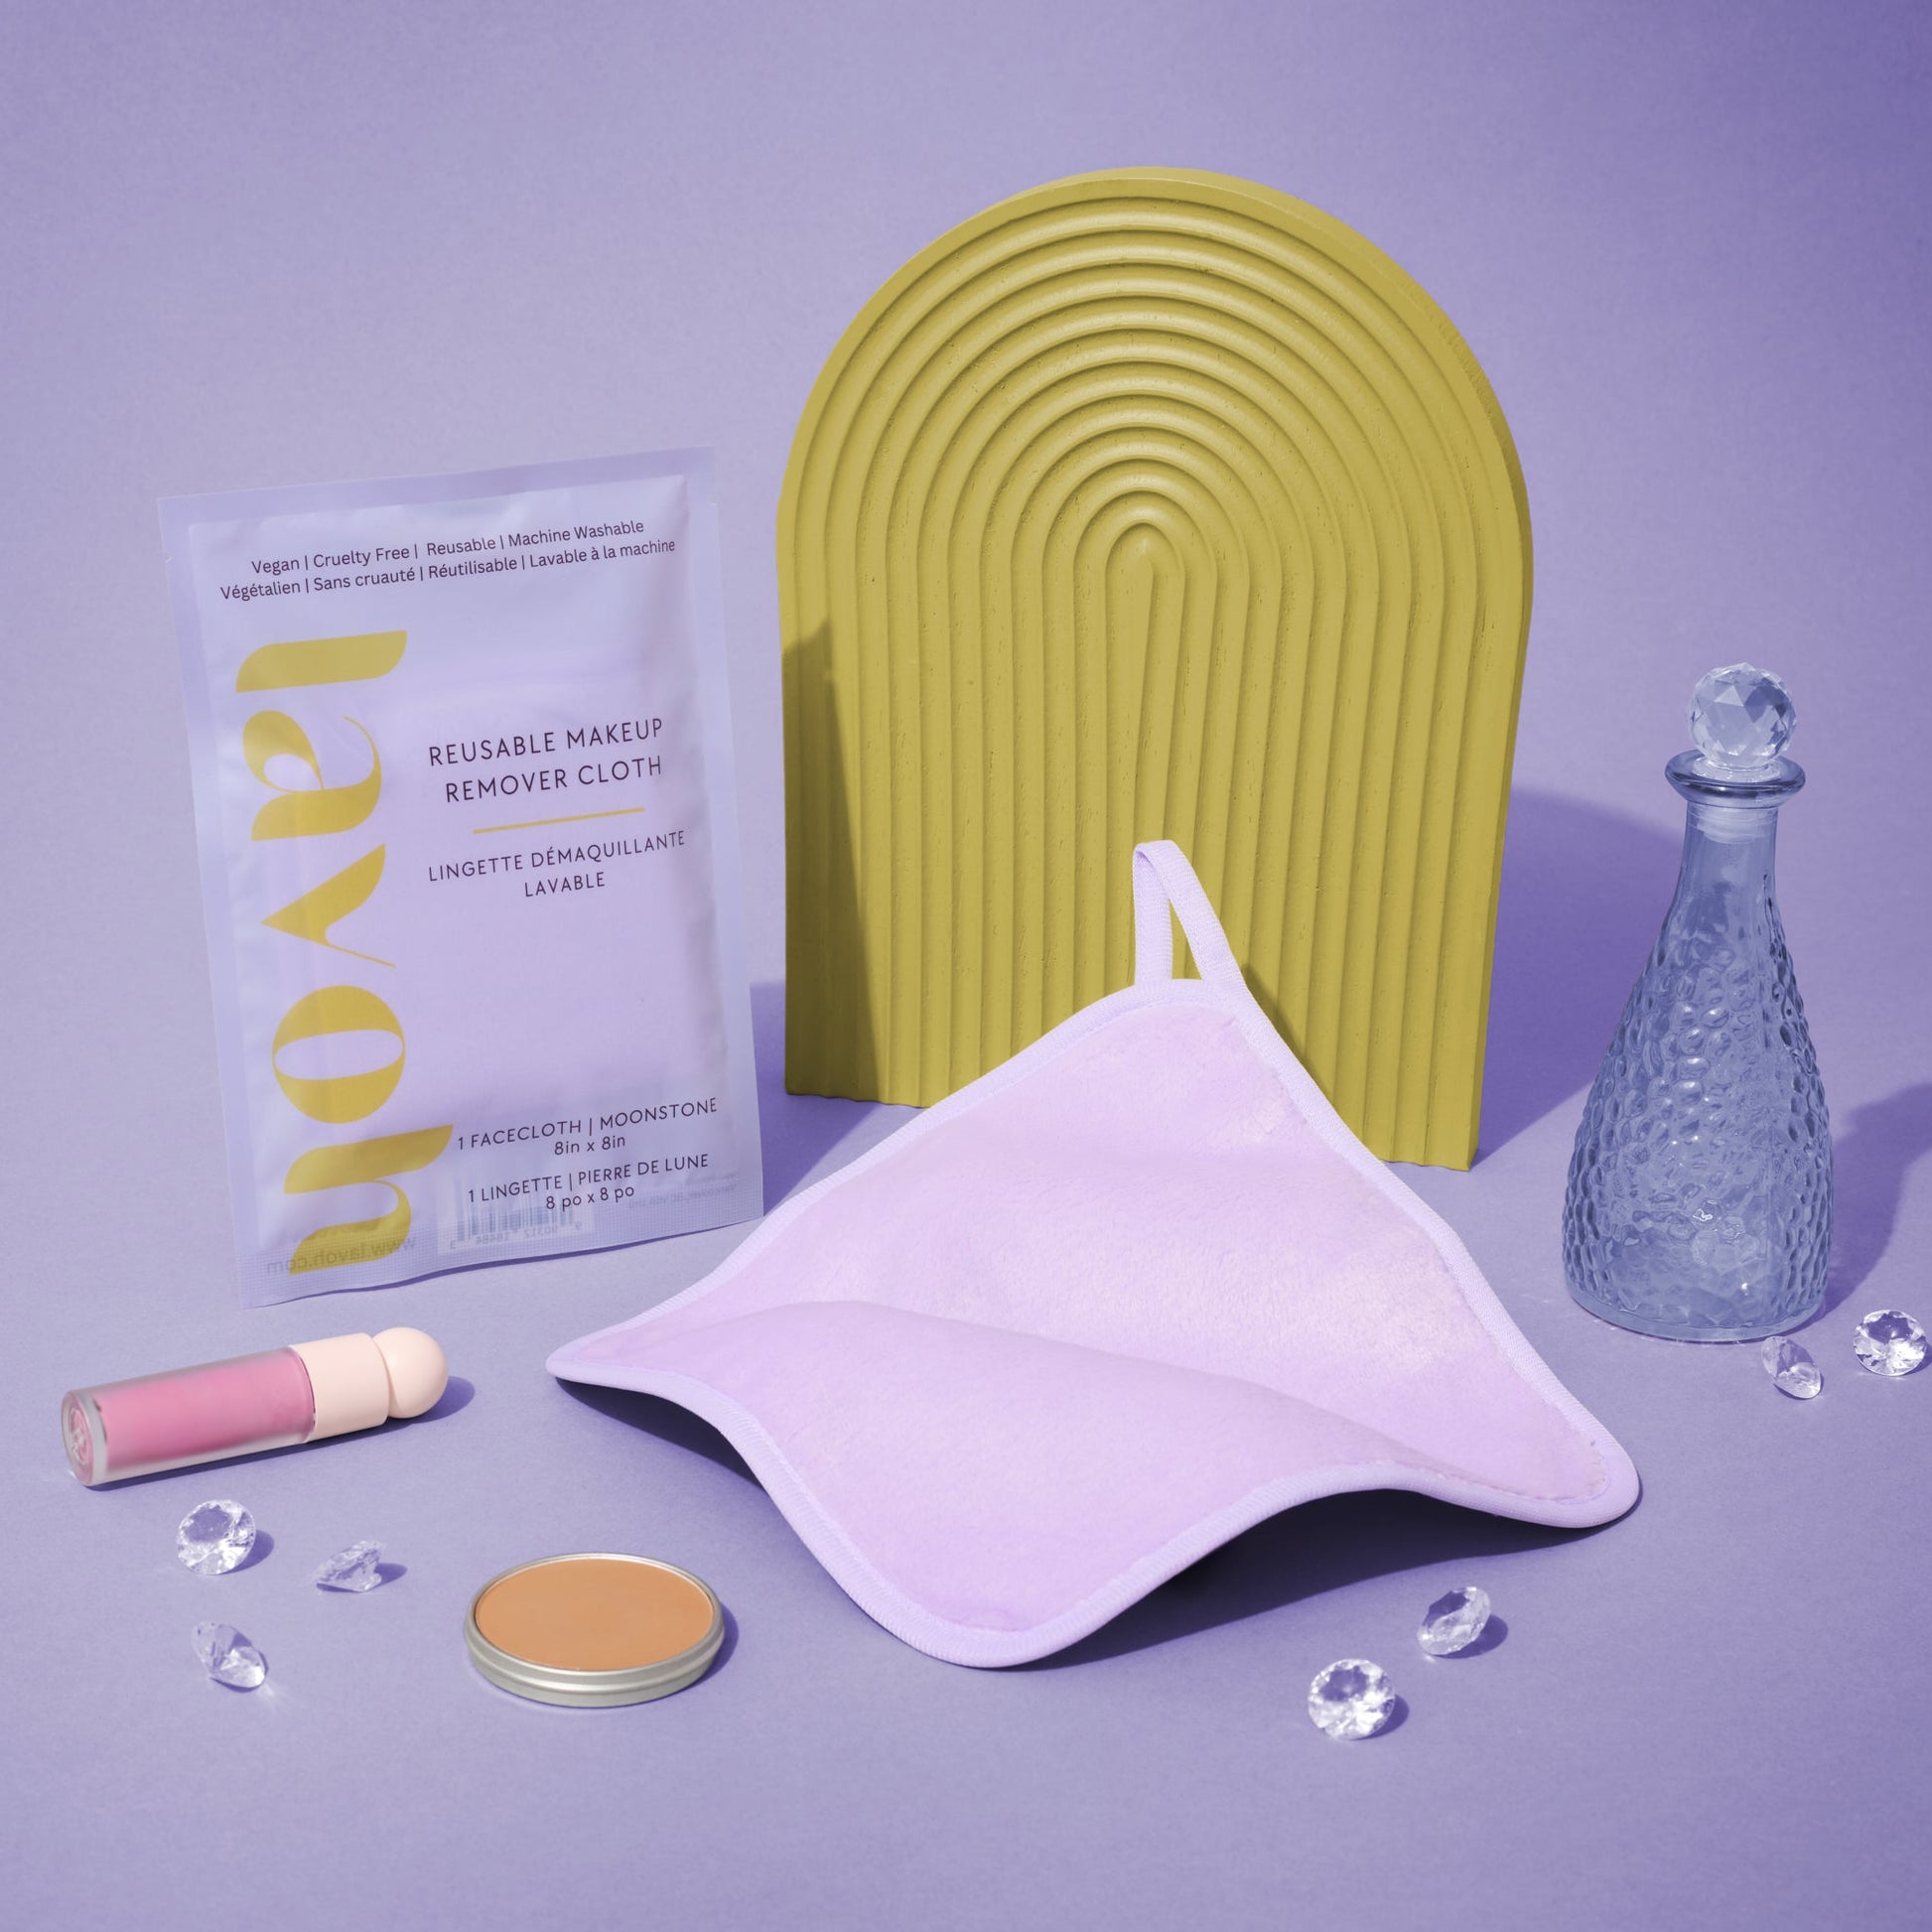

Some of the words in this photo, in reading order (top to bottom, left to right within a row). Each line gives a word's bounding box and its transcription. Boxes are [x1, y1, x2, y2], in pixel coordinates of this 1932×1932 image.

[219, 578, 301, 602] Végétalien
[313, 577, 351, 592] Sans
[354, 566, 416, 587] cruauté
[428, 556, 518, 580] Réutilisable
[529, 548, 588, 568] Lavable
[591, 546, 601, 561] à
[603, 544, 618, 560] la
[620, 540, 676, 557] machine
[250, 556, 300, 576] Vegan
[313, 549, 371, 568] Cruelty
[375, 547, 410, 562] Free
[426, 537, 496, 557] Reusable
[507, 528, 571, 548] Machine
[573, 519, 644, 540] Washable
[428, 731, 556, 767] REUSABLE
[566, 717, 662, 750] MAKEUP
[445, 768, 568, 803] REMOVER
[577, 755, 661, 785] CLOTH
[428, 854, 524, 883] LINGETTE
[530, 830, 685, 869] DÉMAQUILLANTE
[524, 871, 606, 897] LAVABLE
[456, 1135, 465, 1151] 1
[471, 1119, 582, 1149] FACECLOTH
[600, 1096, 718, 1131] MOONSTONE
[554, 1140, 580, 1156] 8in
[586, 1141, 596, 1153] x
[601, 1135, 625, 1151] 8in
[468, 1188, 475, 1203] 1
[481, 1174, 563, 1202] LINGETTE
[578, 1164, 631, 1186] PIERRE
[637, 1160, 659, 1176] DE
[664, 1153, 709, 1173] LUNE
[545, 1195, 556, 1210] 8
[561, 1194, 582, 1213] po
[587, 1192, 596, 1204] x
[600, 1186, 610, 1201] 8
[614, 1186, 634, 1203] po
